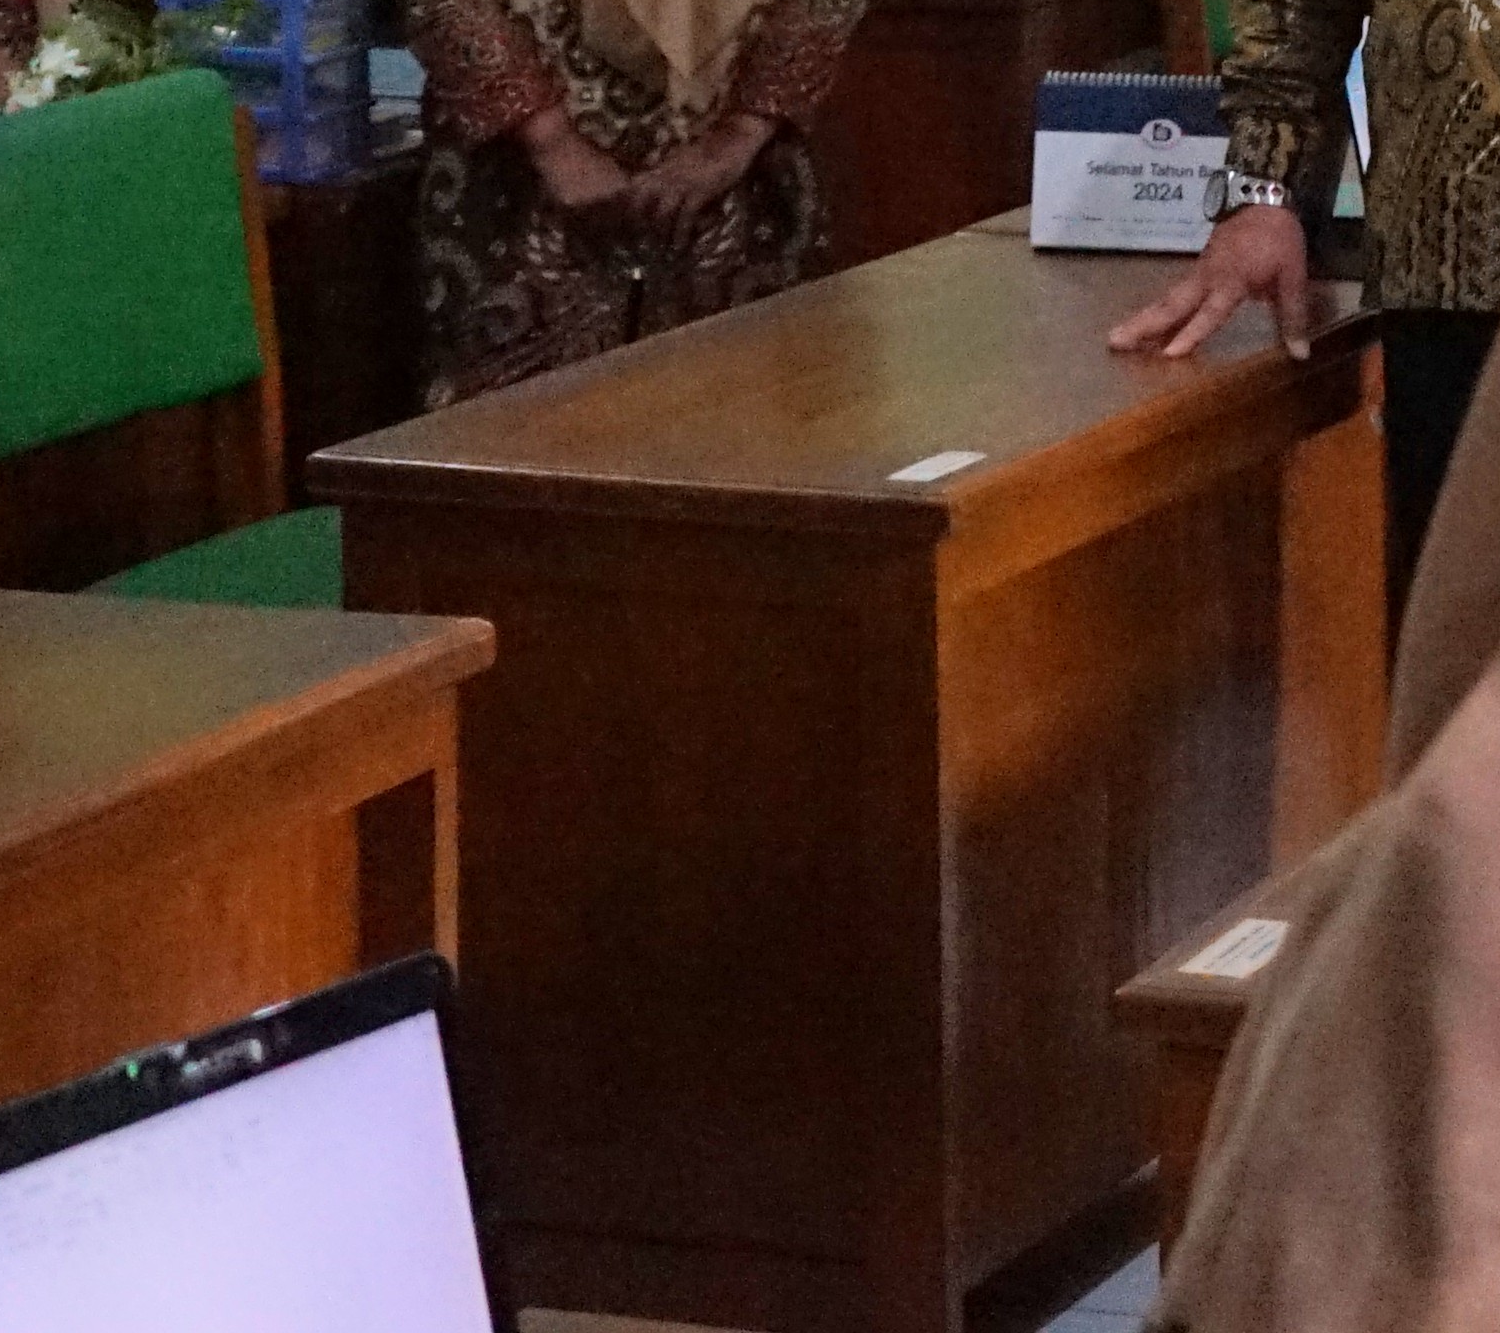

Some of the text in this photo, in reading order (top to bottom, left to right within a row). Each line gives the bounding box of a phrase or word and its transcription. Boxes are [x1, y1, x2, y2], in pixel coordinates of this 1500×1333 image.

[1087, 160, 1144, 177] Selamat
[1150, 161, 1194, 178] Tahun
[1133, 183, 1184, 202] 2024
